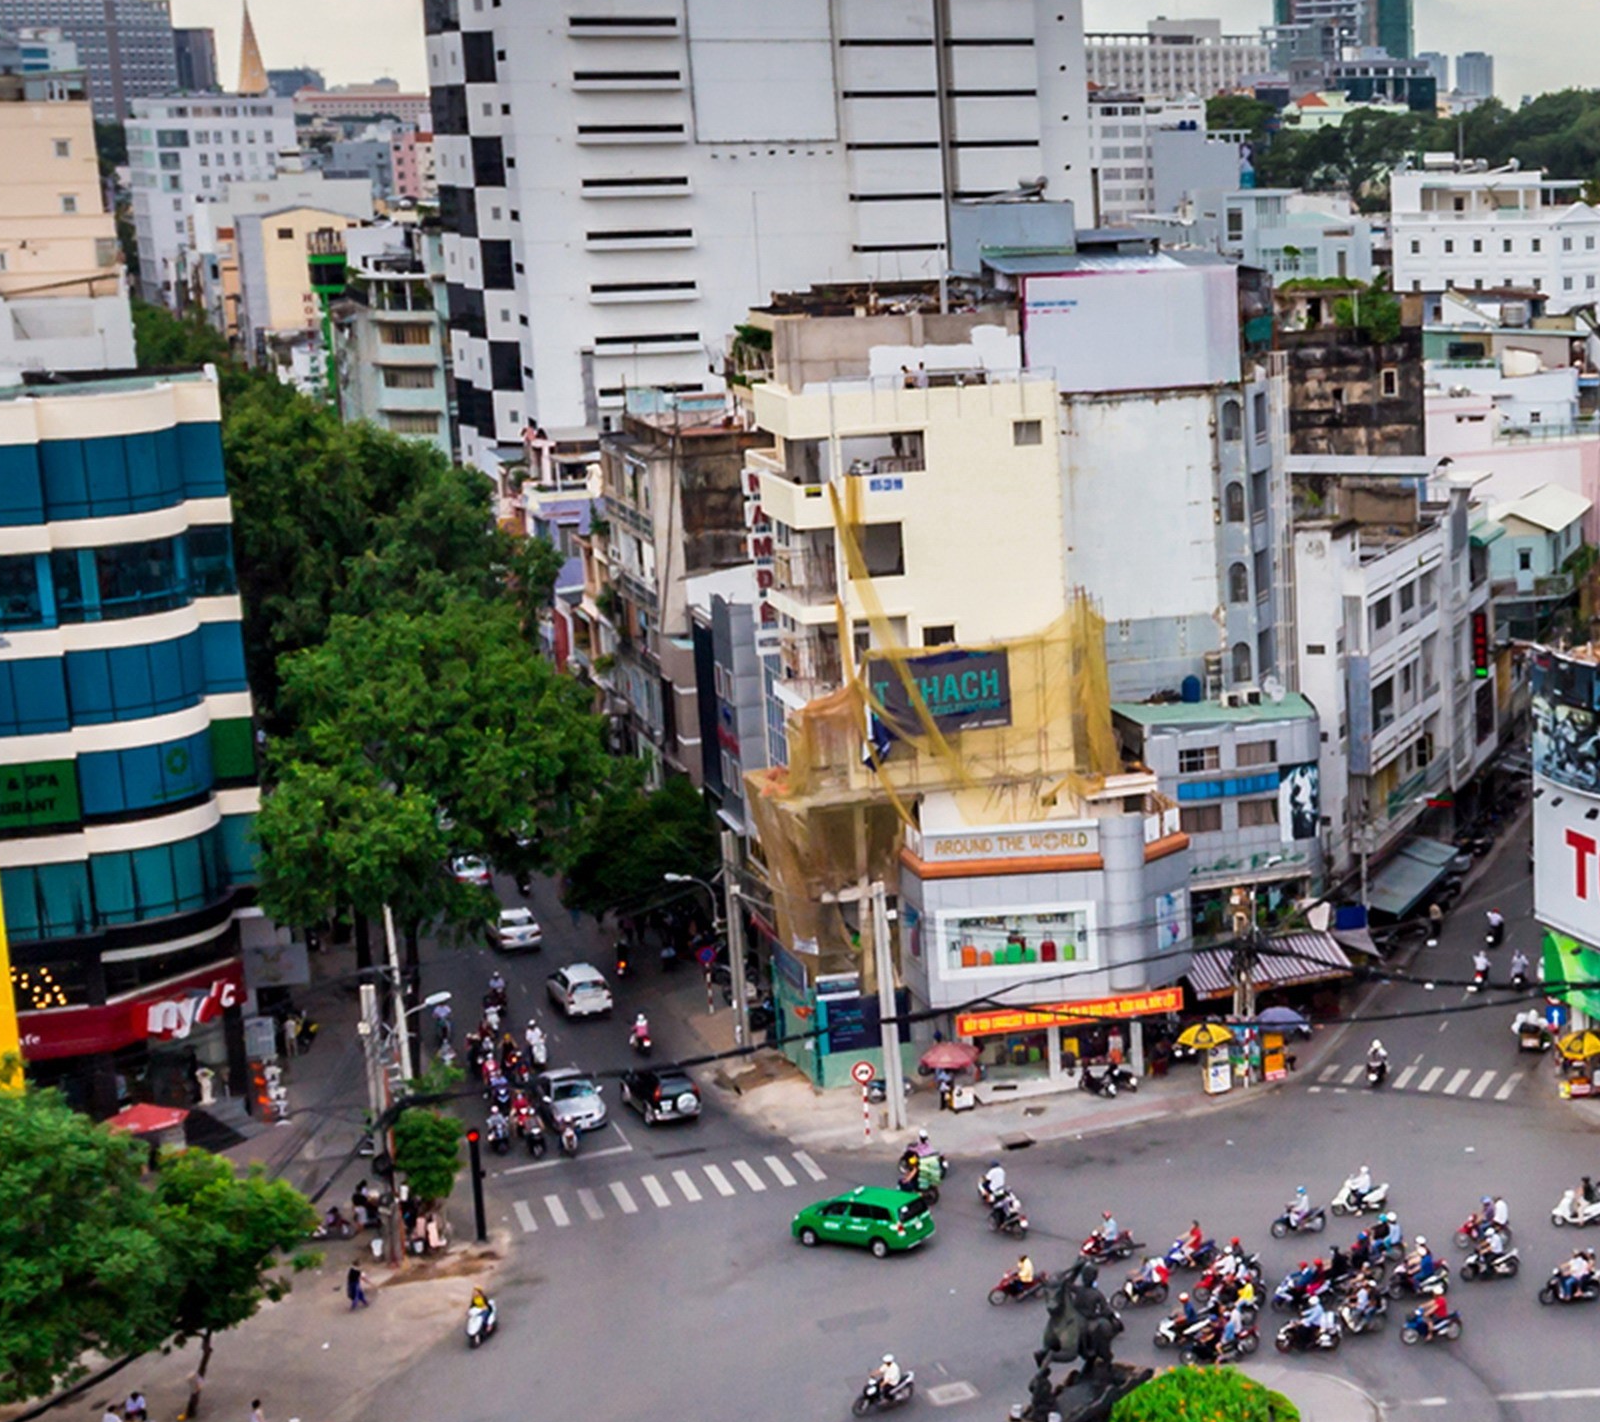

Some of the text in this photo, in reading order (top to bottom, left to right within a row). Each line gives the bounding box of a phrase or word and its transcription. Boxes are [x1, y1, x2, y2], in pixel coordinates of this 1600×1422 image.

[934, 831, 1088, 856] AROUND THE WORLD
